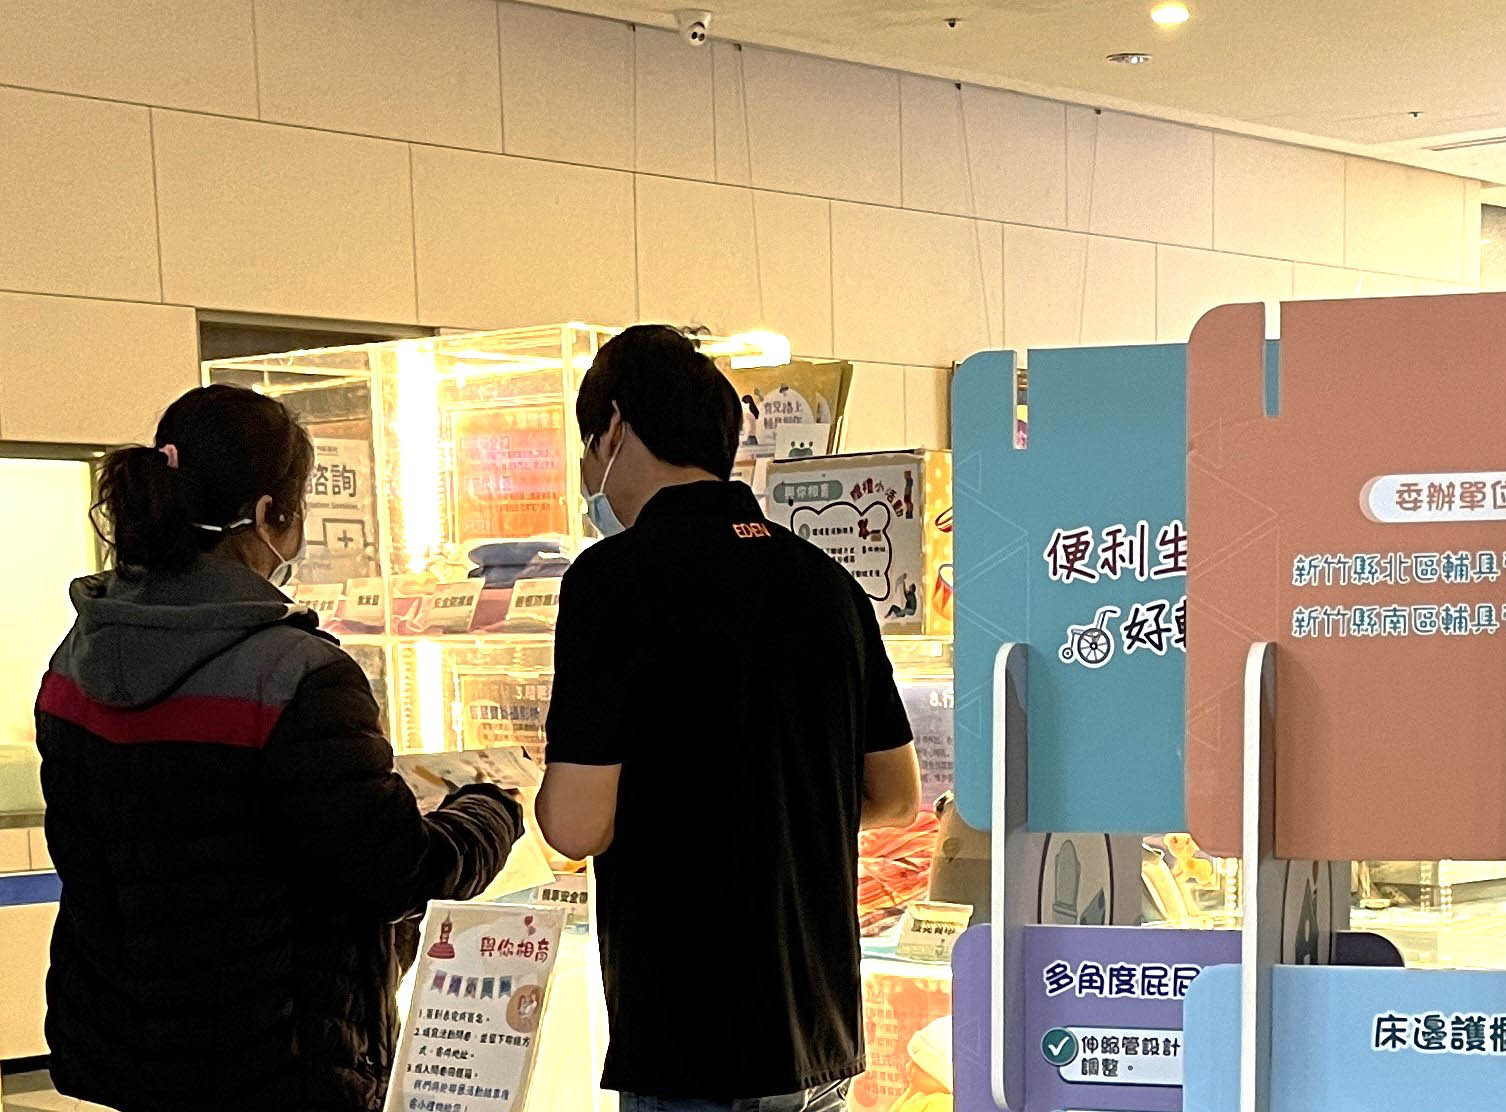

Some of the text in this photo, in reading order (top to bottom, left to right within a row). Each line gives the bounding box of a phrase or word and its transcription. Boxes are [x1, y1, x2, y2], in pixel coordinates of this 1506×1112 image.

[732, 521, 772, 538] EDEN
[1045, 522, 1187, 581] 便利生
[1045, 962, 1200, 998] 多角度屁屁
[1081, 1035, 1181, 1057] 伸縮管設計
